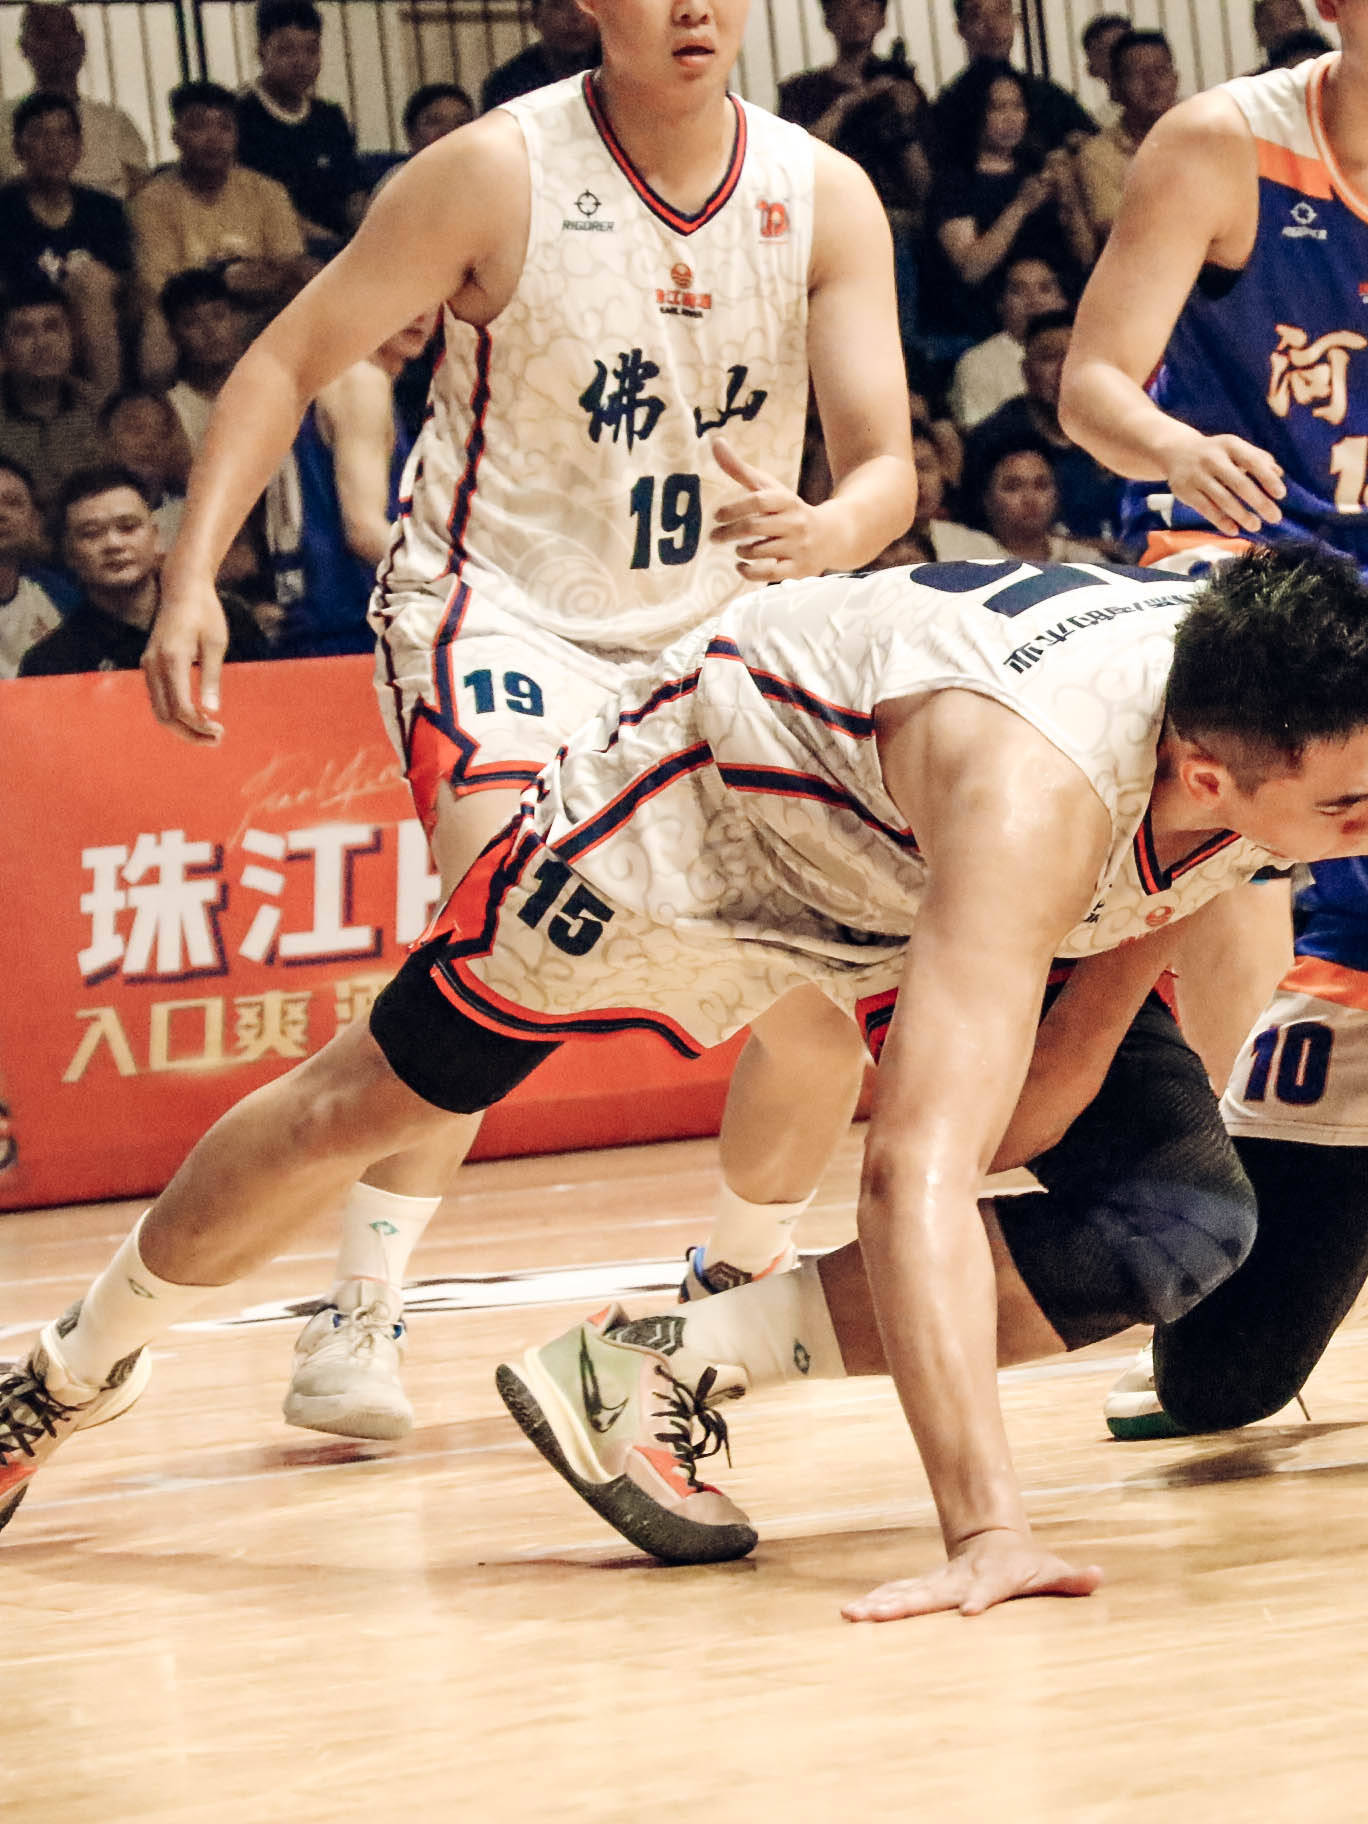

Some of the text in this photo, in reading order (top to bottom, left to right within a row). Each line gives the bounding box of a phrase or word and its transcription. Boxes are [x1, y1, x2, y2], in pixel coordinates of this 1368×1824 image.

[578, 348, 768, 455] 佛山
[630, 473, 702, 570] 19
[463, 668, 545, 718] 19
[77, 819, 442, 980] 珠江
[516, 858, 616, 957] 15
[1242, 1021, 1336, 1108] 10
